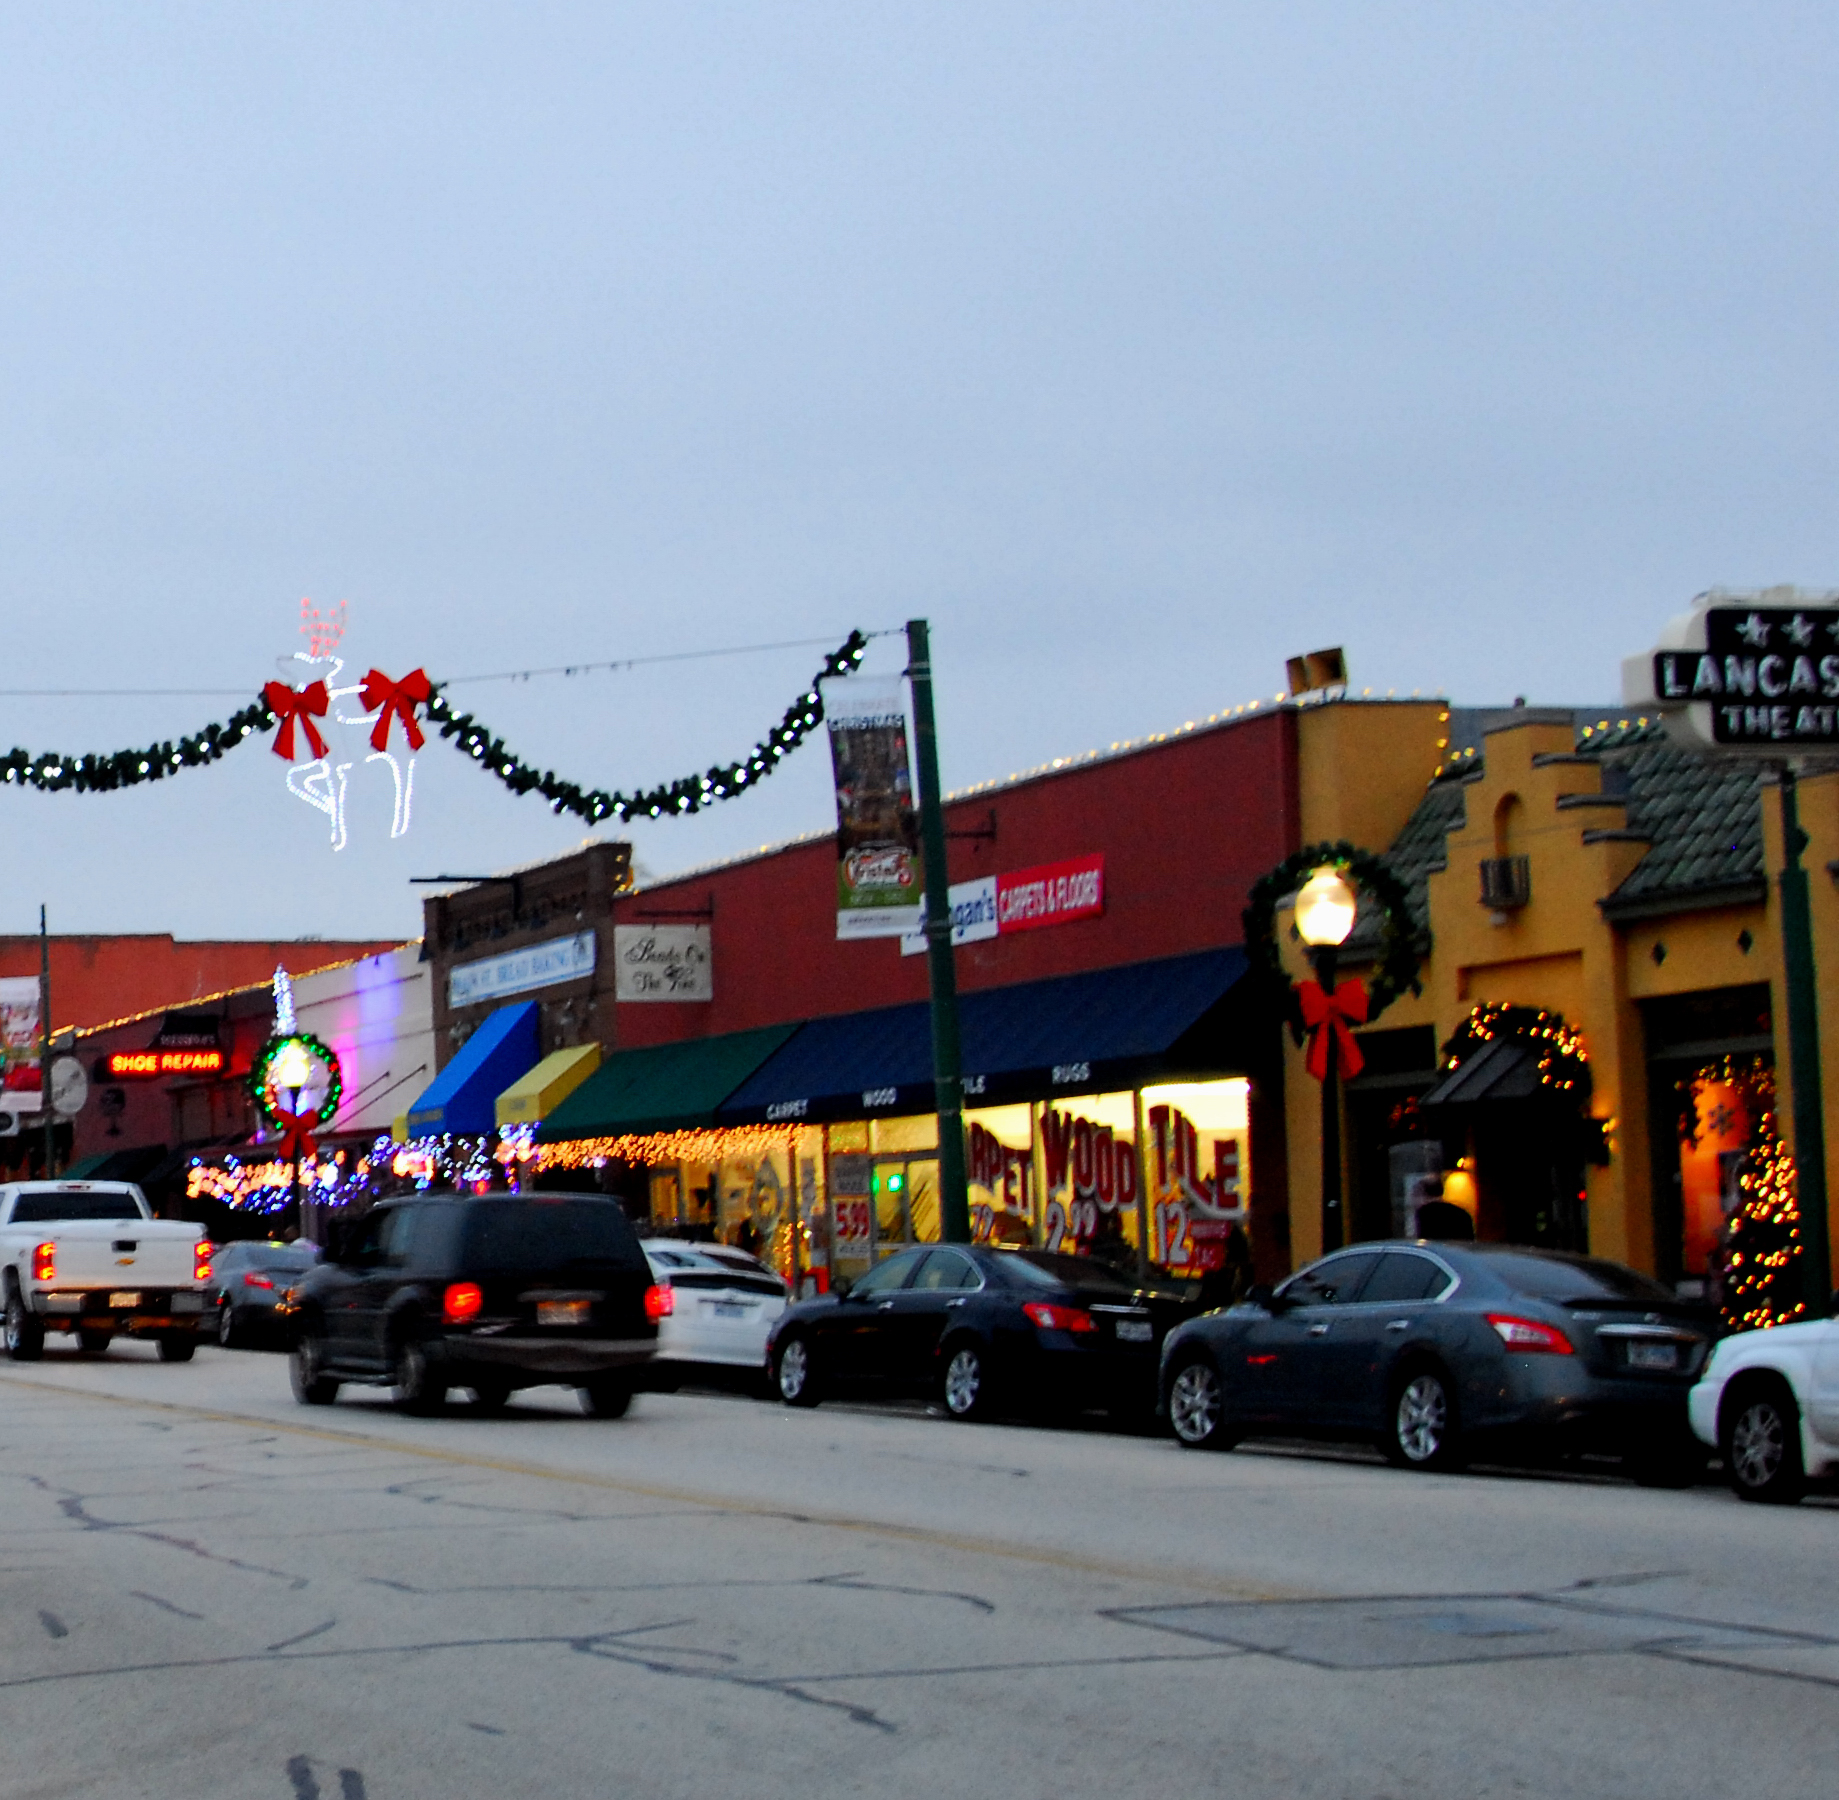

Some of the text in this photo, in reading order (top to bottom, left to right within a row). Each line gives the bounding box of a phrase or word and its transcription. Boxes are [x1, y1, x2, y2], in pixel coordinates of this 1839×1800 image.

[1663, 654, 1839, 698] LANCAS
[1721, 705, 1839, 739] THEAT
[112, 1053, 220, 1071] SHOE REPAIR
[766, 1098, 809, 1121] CARPET
[862, 1087, 898, 1107] WOOD
[1051, 1062, 1091, 1084] RUGS
[967, 1104, 1246, 1217] RPET WOOD TILE
